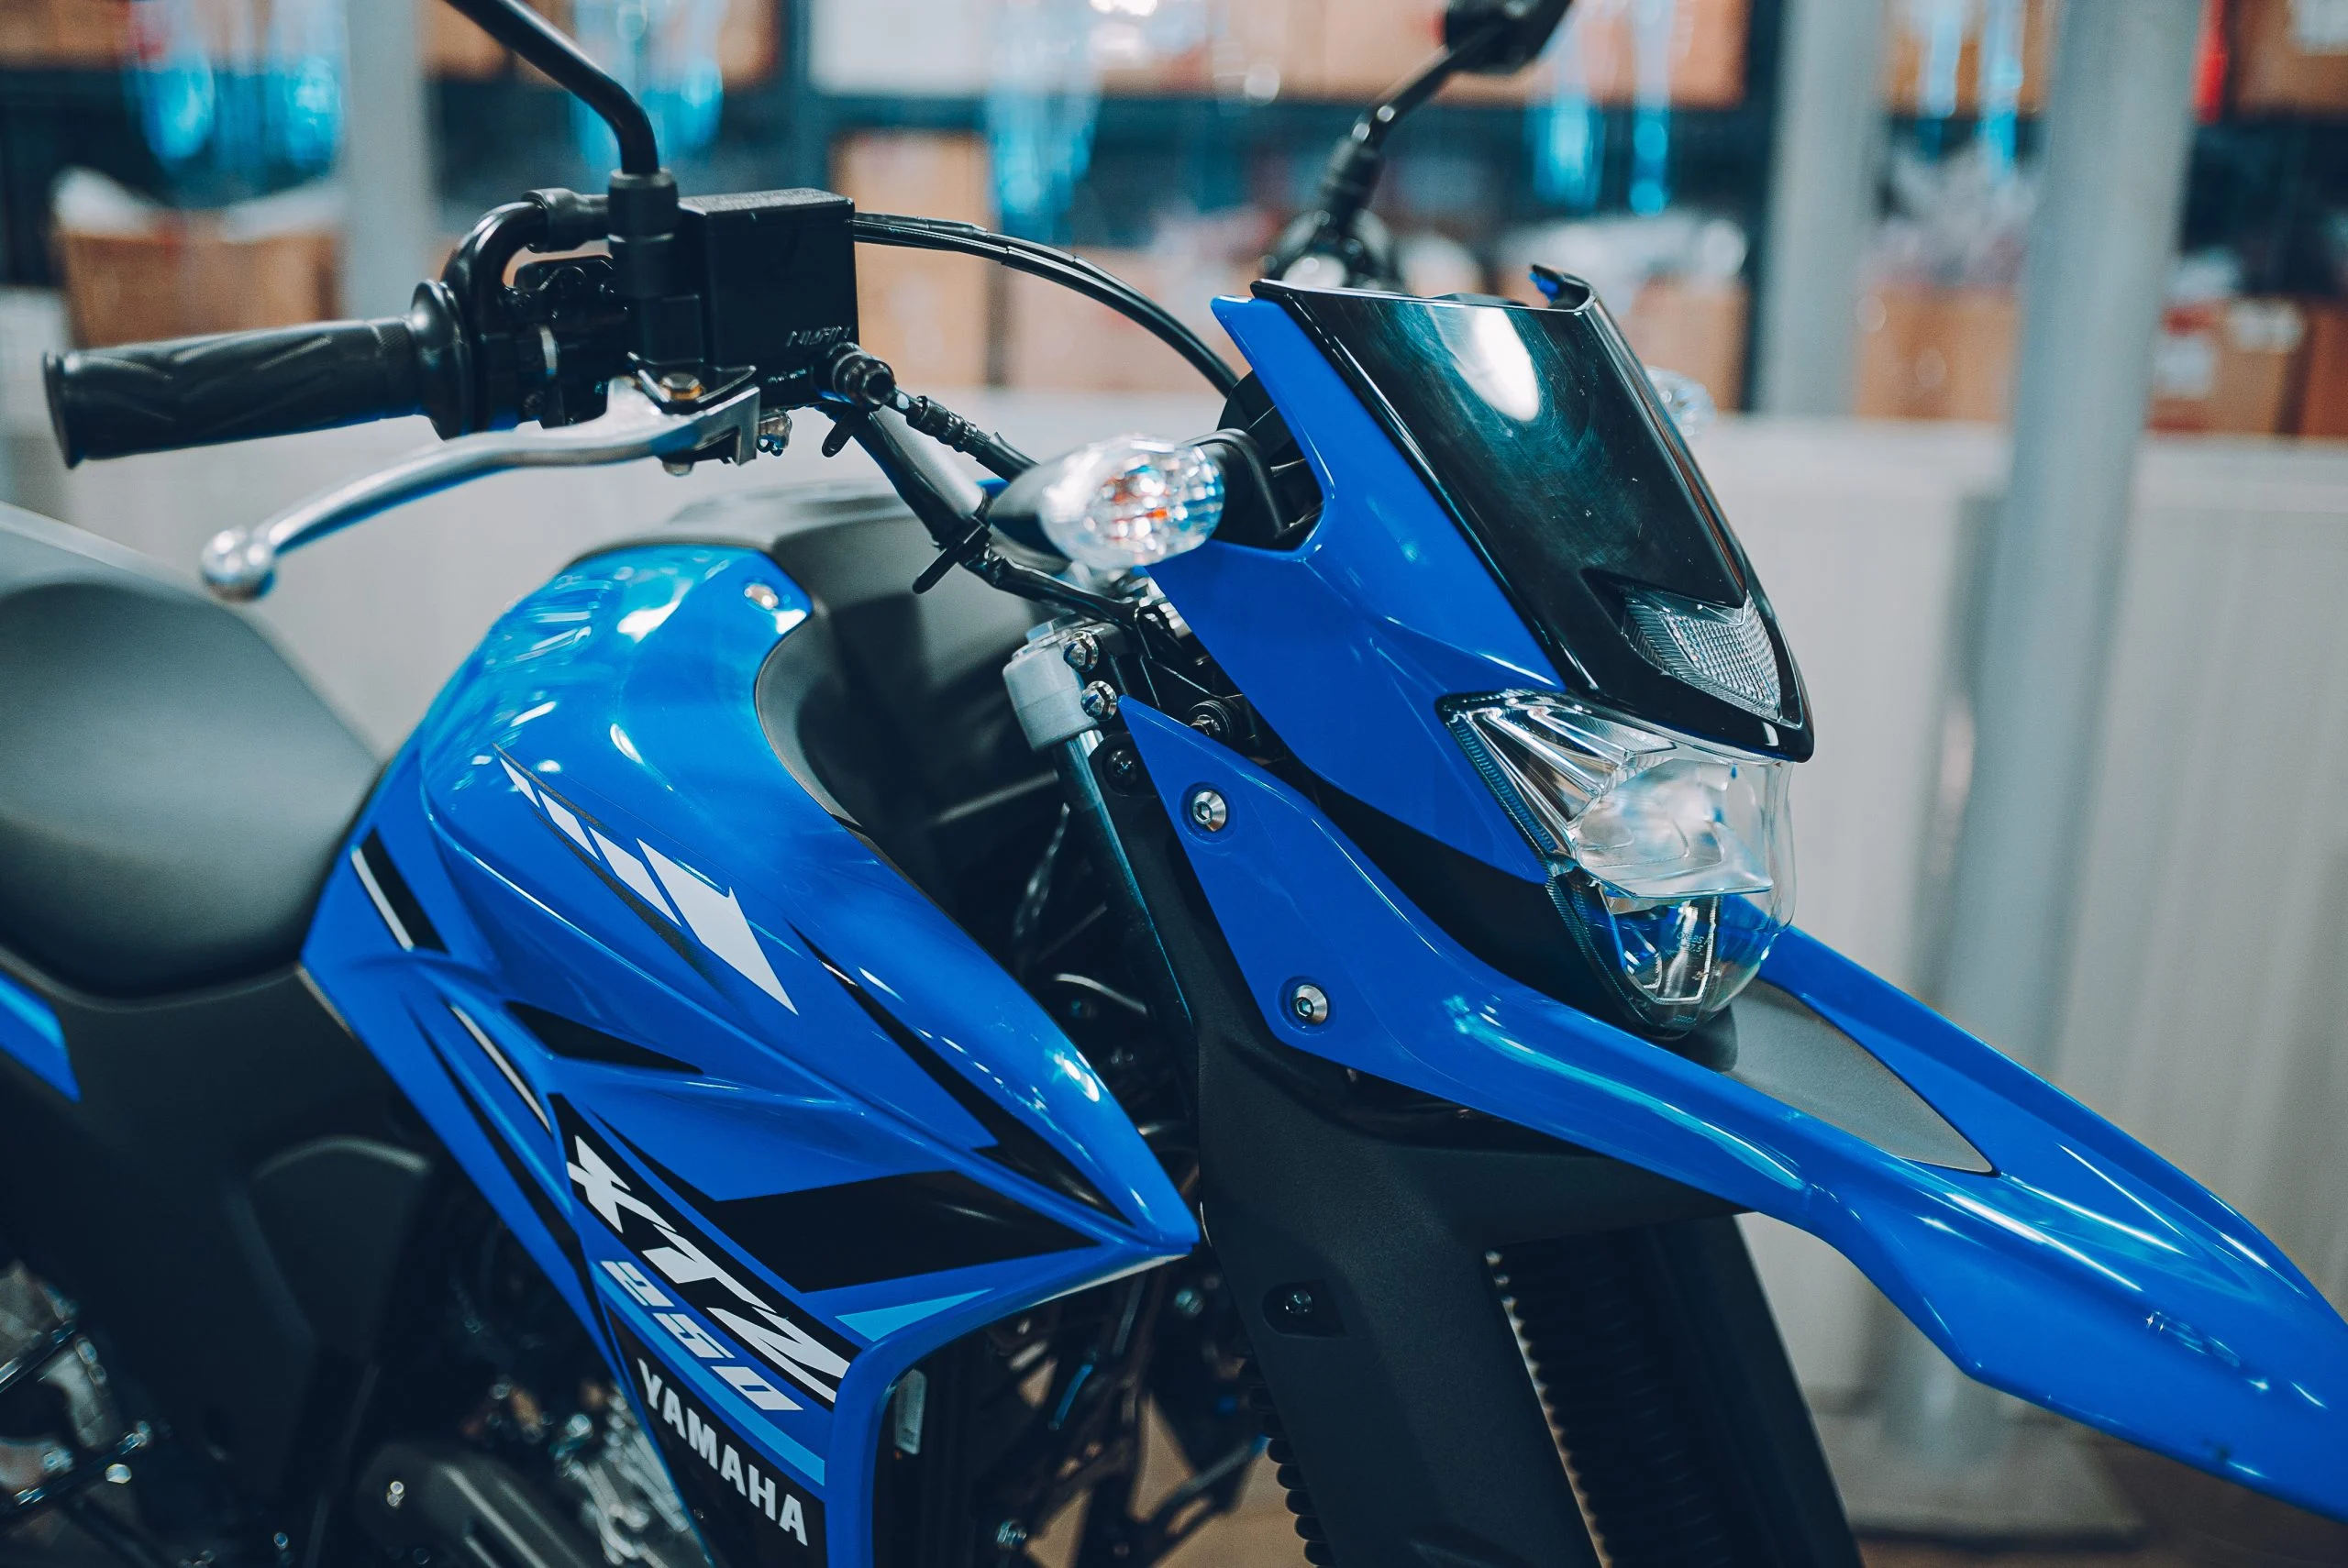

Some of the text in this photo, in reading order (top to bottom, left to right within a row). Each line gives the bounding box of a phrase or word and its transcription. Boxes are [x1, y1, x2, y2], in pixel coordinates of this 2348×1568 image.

[566, 1134, 850, 1404] XTZ
[601, 1260, 804, 1410] 250
[637, 1357, 808, 1547] YAMAHA
